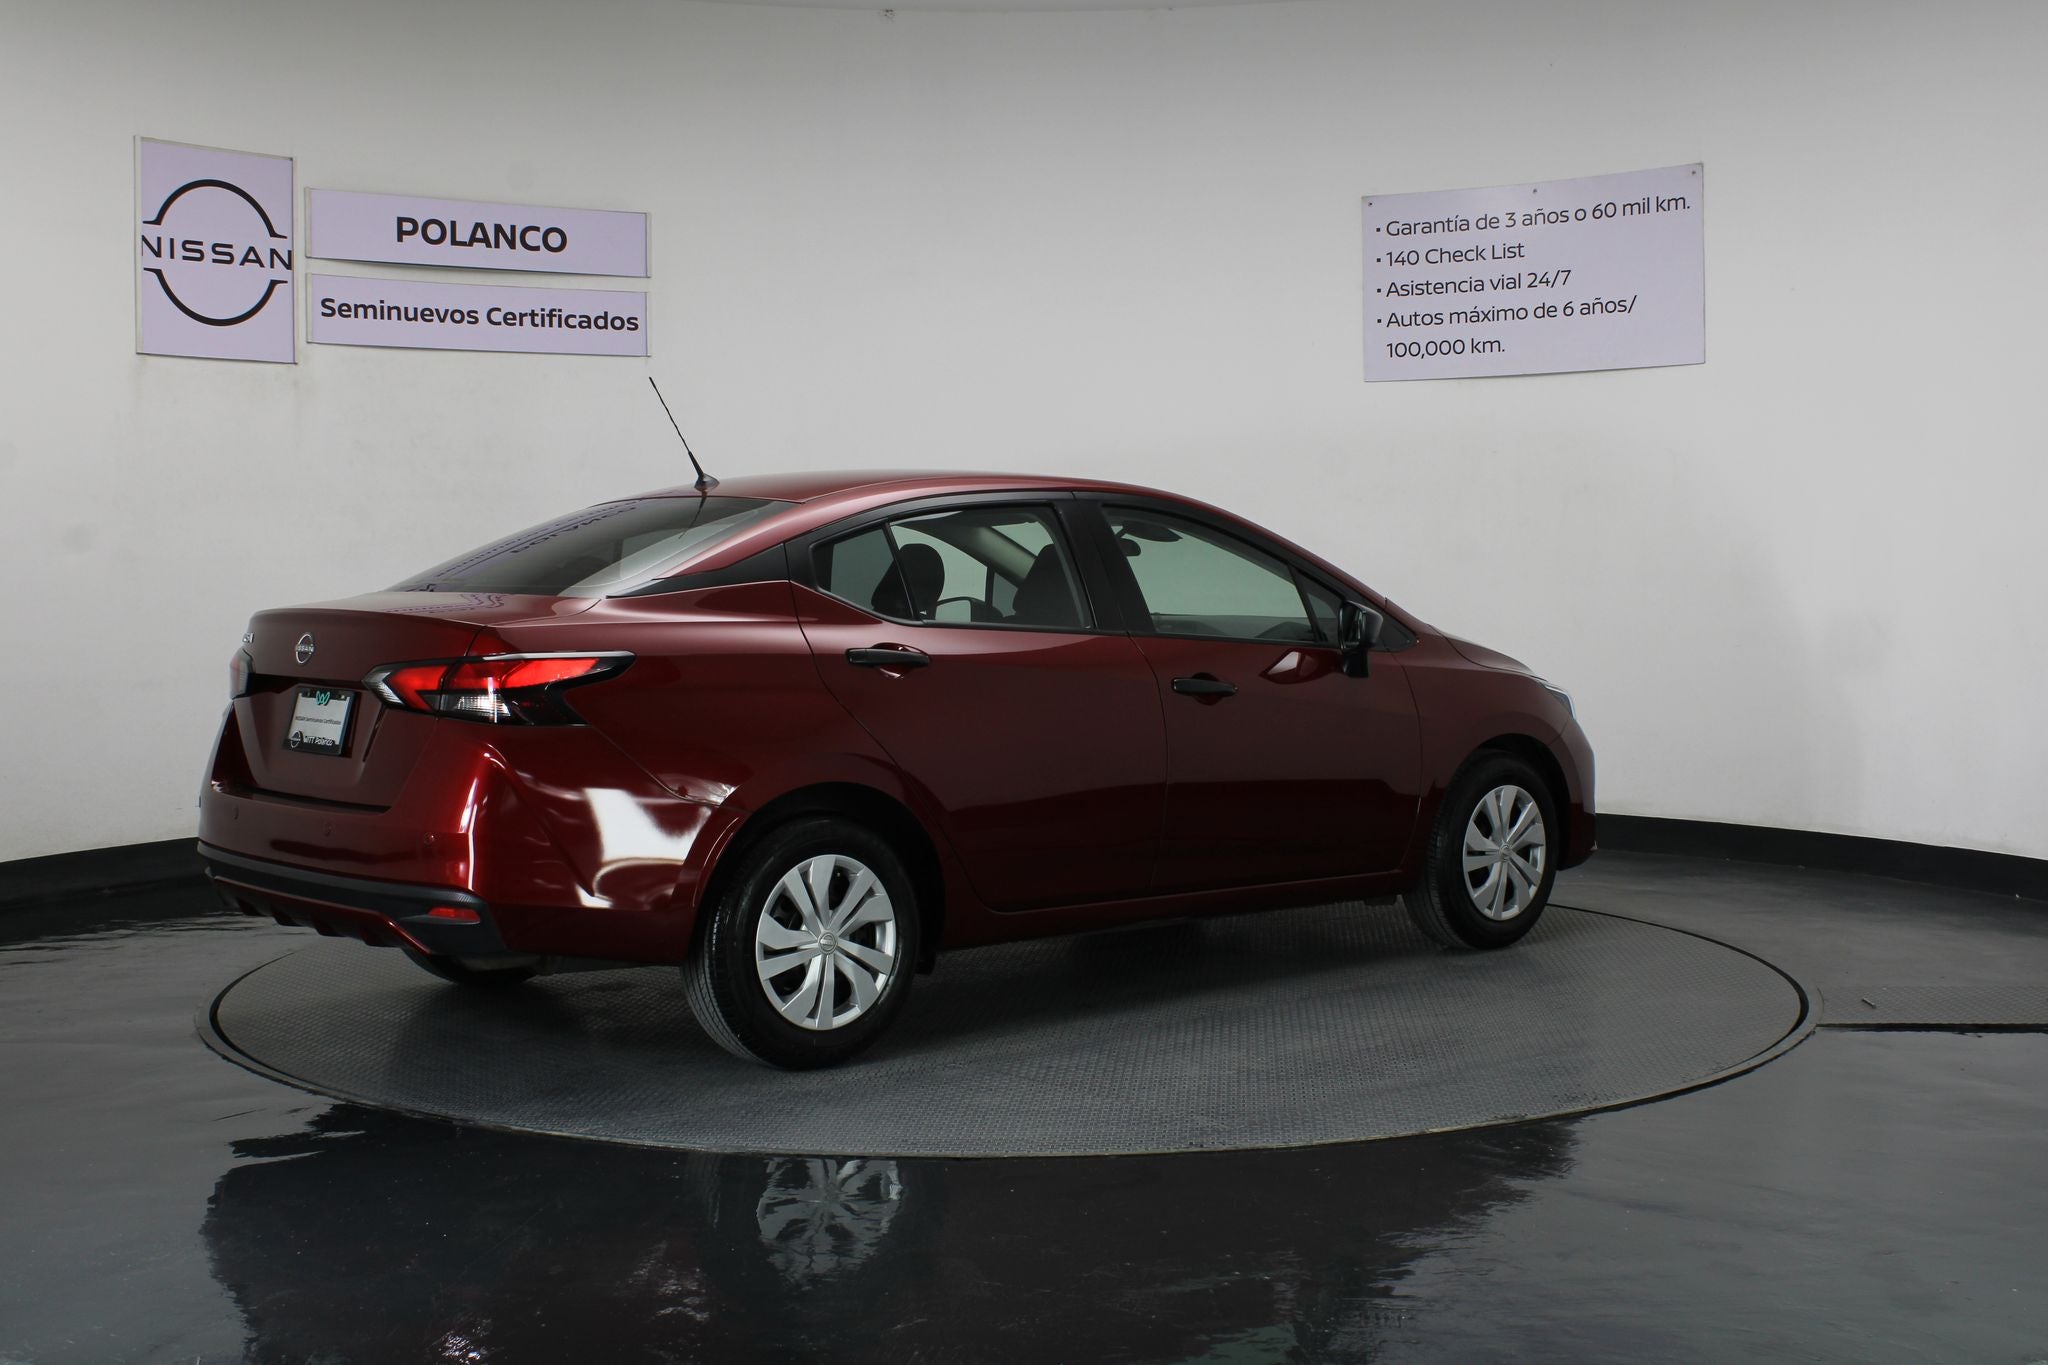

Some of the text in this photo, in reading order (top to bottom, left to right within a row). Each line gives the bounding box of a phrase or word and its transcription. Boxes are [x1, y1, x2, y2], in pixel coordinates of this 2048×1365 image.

[1385, 195, 1691, 237] Garantía de 3 años o 60 mil km.
[396, 216, 568, 254] POLANCO
[141, 234, 293, 271] NISSAN
[1385, 242, 1526, 267] 140 Check List
[1385, 269, 1572, 298] Asistencia vial 24/7
[320, 297, 639, 332] Seminuevos Certificados
[1386, 294, 1638, 328] Autos máximo de 6 años/
[1386, 337, 1505, 360] 100,000 km.
